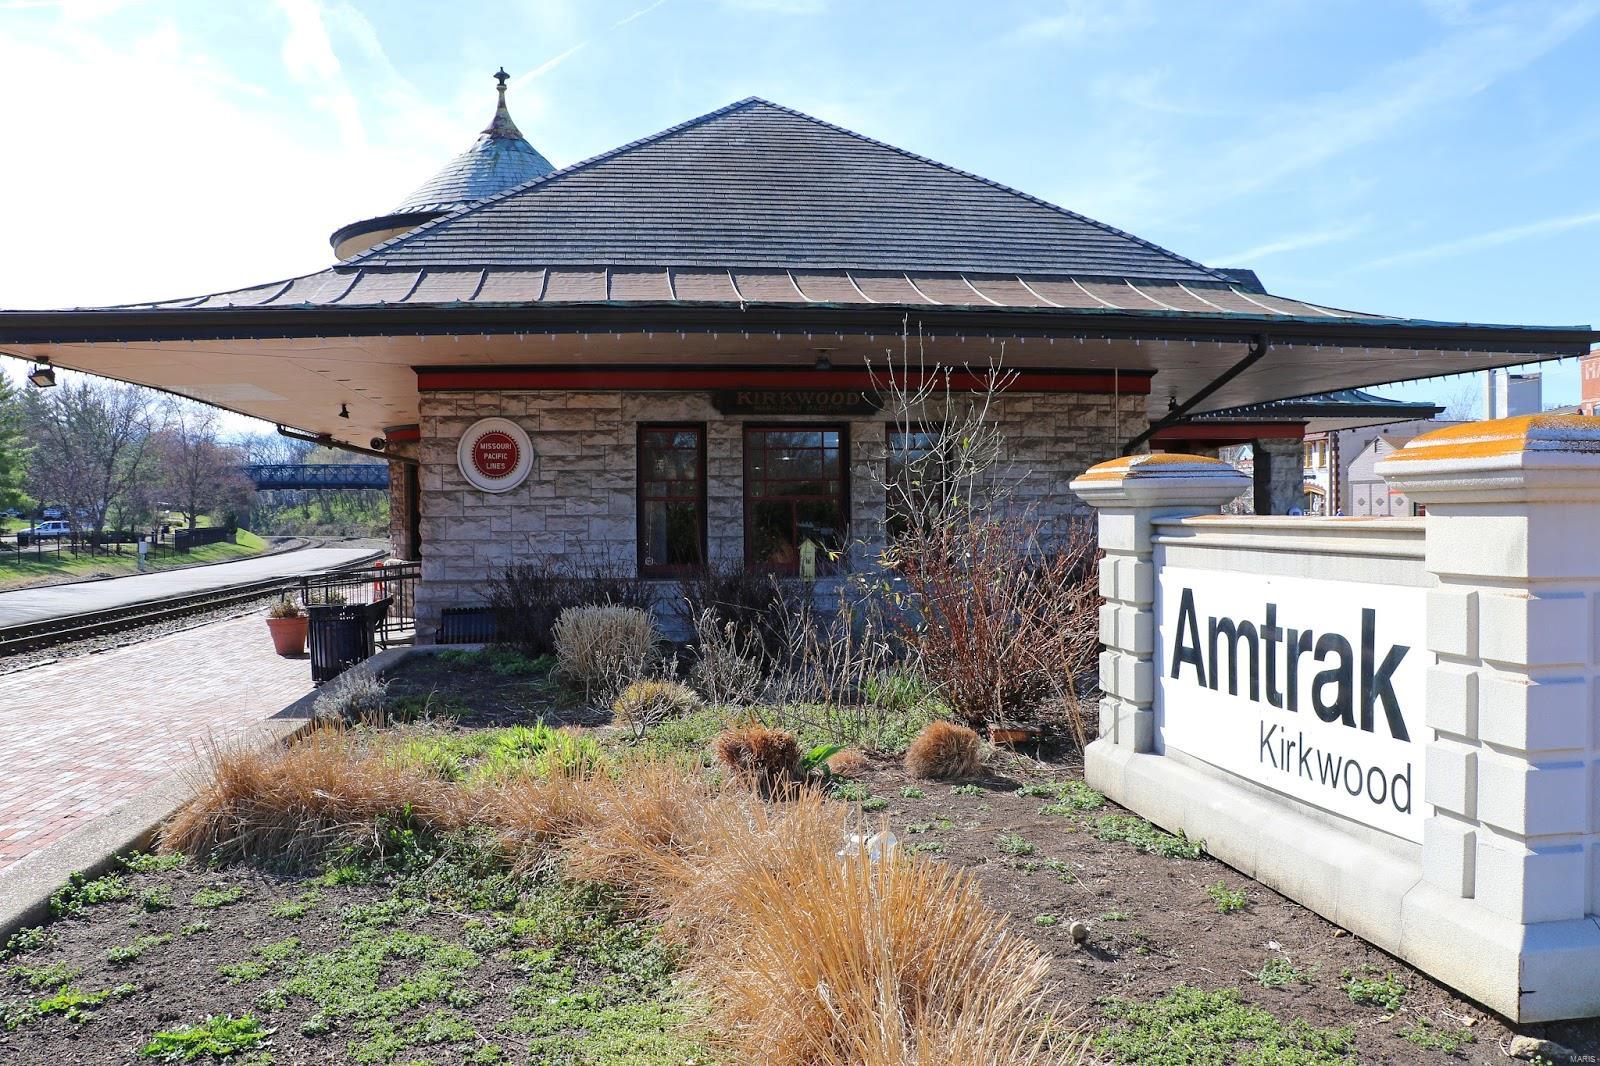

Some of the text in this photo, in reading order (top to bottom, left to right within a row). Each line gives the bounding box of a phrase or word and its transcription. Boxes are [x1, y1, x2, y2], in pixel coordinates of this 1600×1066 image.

[736, 391, 860, 405] KIRKWOOD
[483, 452, 508, 460] PACIFIC
[486, 462, 506, 470] LINES
[1170, 587, 1411, 743] Amtrak
[1259, 719, 1412, 815] Kirkwood
